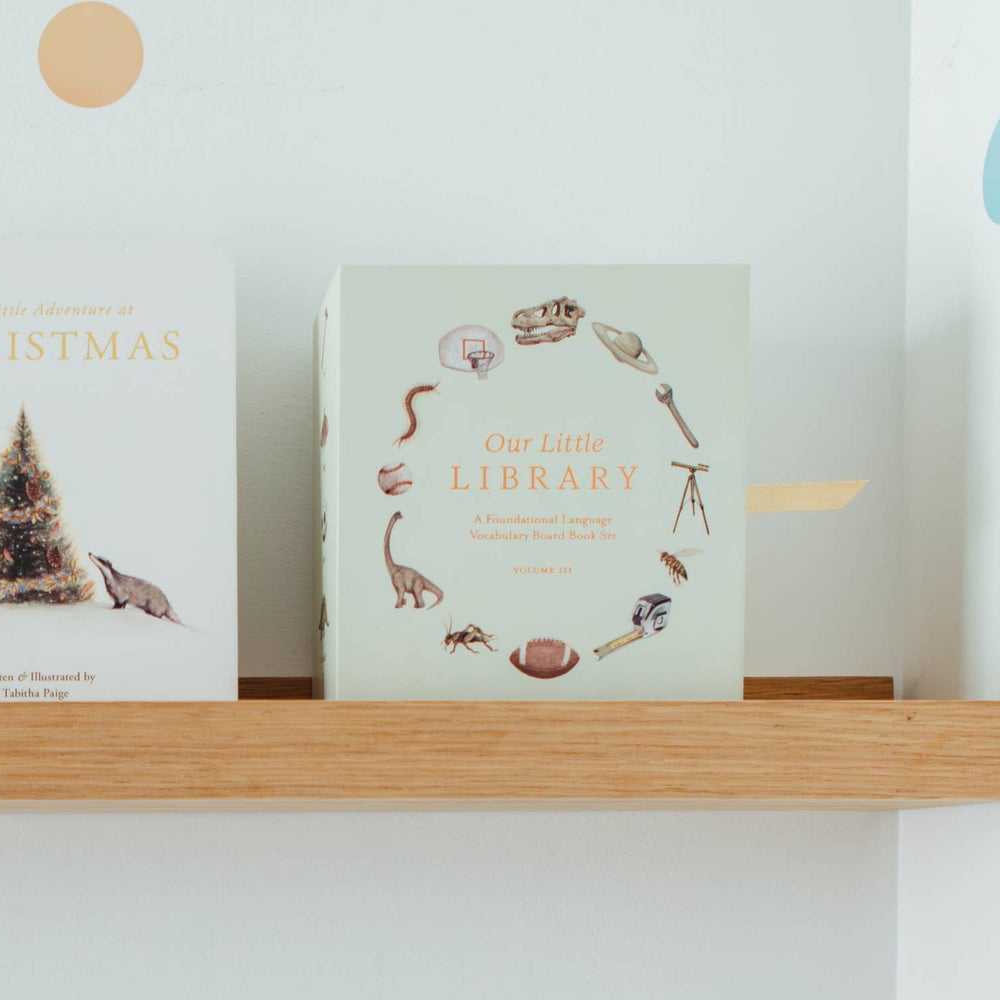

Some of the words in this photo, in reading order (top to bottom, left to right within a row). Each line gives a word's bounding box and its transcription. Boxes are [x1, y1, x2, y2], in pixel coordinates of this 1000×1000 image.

[33, 302, 111, 316] Adventure
[118, 304, 134, 316] at
[485, 432, 533, 453] Our
[540, 432, 604, 453] Little
[450, 465, 639, 490] LIBRARY
[474, 514, 482, 524] A
[486, 514, 558, 524] Foundational
[562, 514, 613, 527] Language
[469, 530, 529, 543] Vocabulary
[533, 530, 565, 540] Board
[569, 530, 596, 540] Book
[600, 530, 616, 540] Set
[513, 566, 555, 574] VOLUME
[558, 566, 572, 574] III
[17, 671, 28, 682] &
[31, 671, 80, 682] Illustrated
[84, 671, 96, 684] by
[3, 688, 39, 698] Tabitha
[43, 688, 69, 700] Paige
